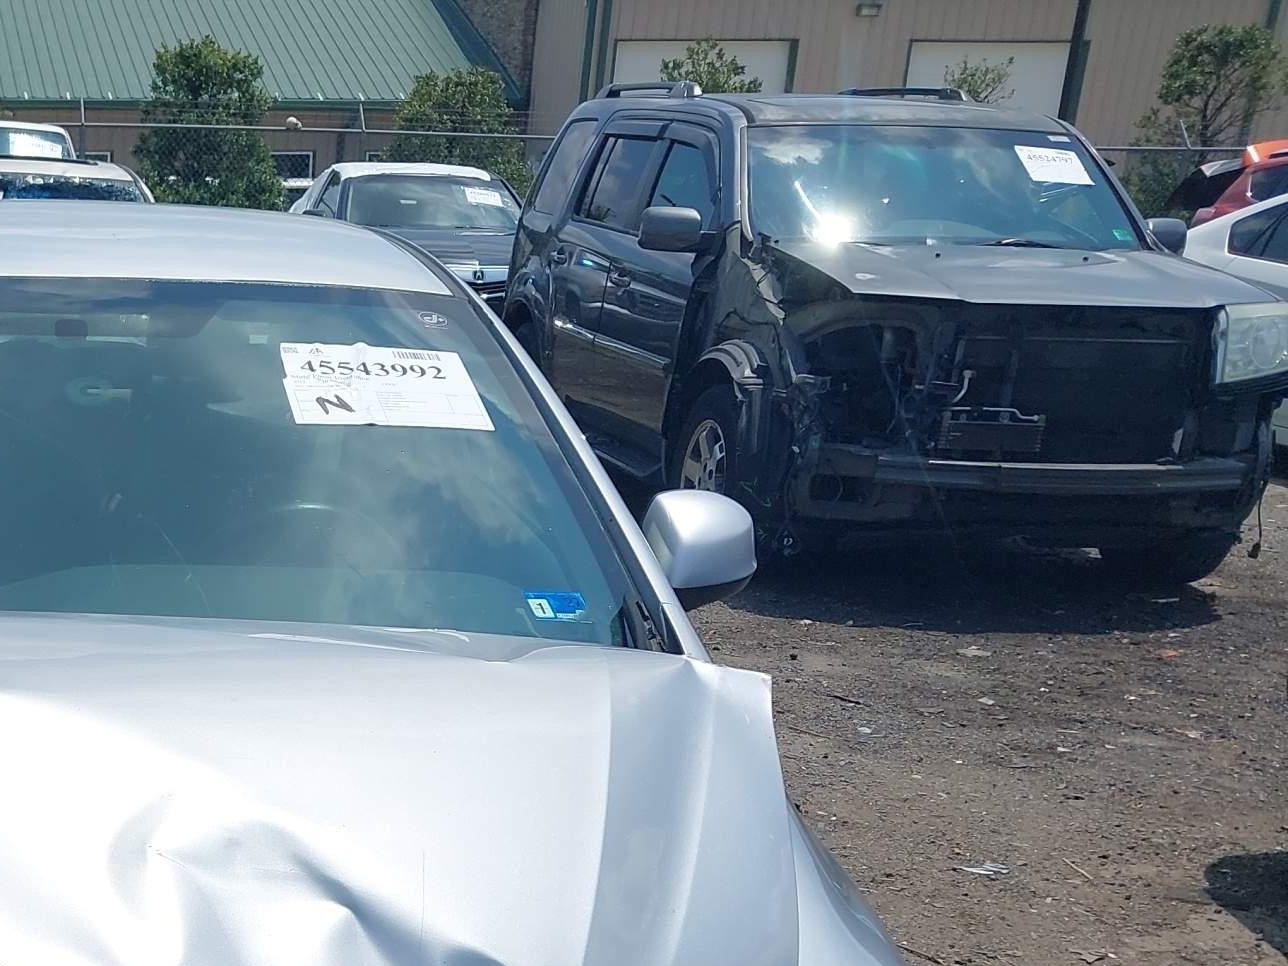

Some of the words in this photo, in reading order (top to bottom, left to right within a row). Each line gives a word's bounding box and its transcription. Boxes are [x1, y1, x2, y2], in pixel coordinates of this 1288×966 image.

[300, 360, 446, 380] 45543992
[315, 393, 357, 416] N
[535, 602, 547, 615] 1
